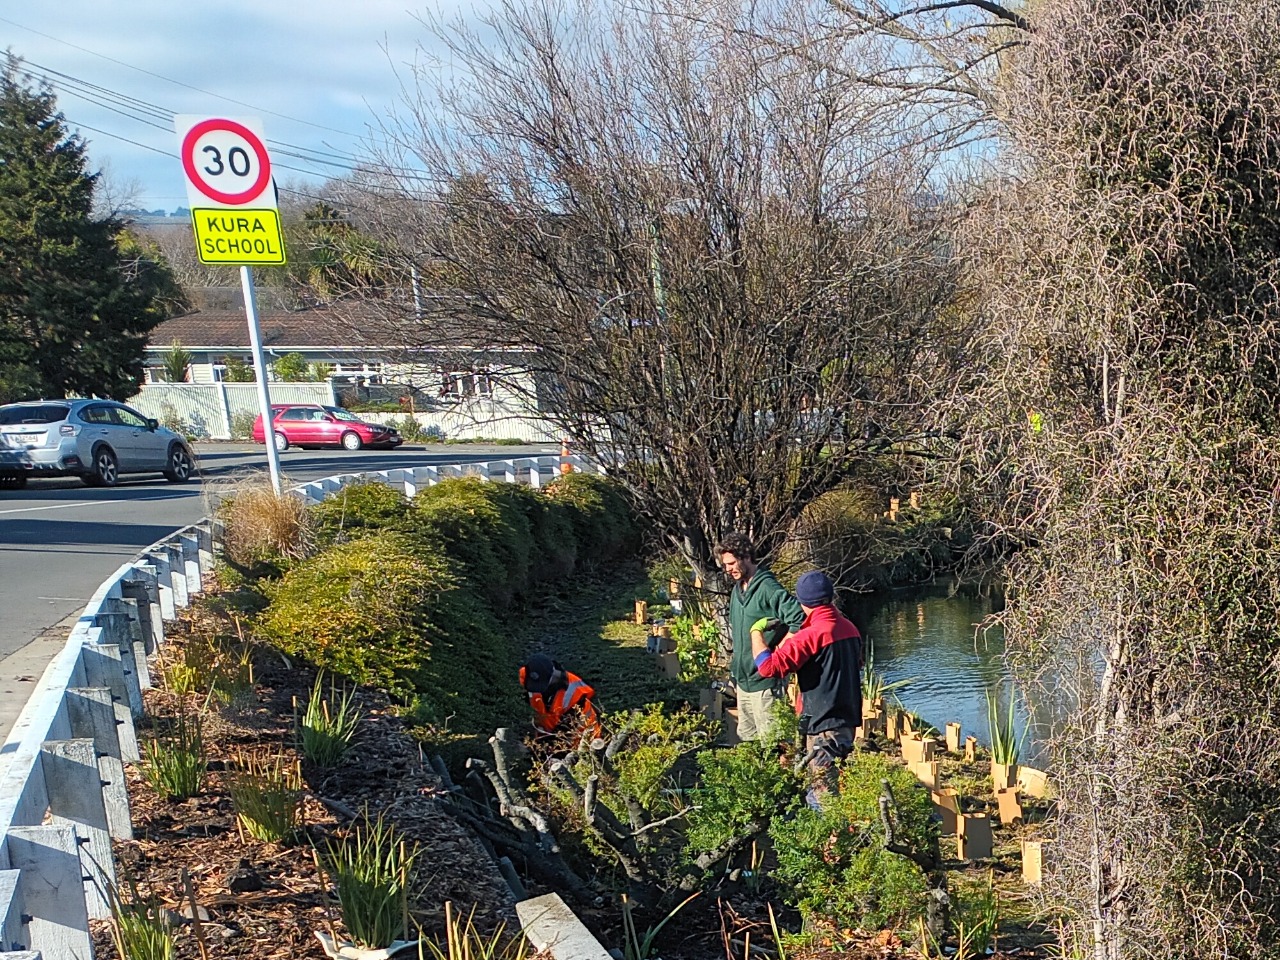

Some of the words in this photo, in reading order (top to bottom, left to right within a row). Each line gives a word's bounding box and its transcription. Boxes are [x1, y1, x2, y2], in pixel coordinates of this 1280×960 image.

[202, 145, 250, 177] 30
[207, 217, 266, 233] KURA
[204, 238, 277, 254] SCHOOL
